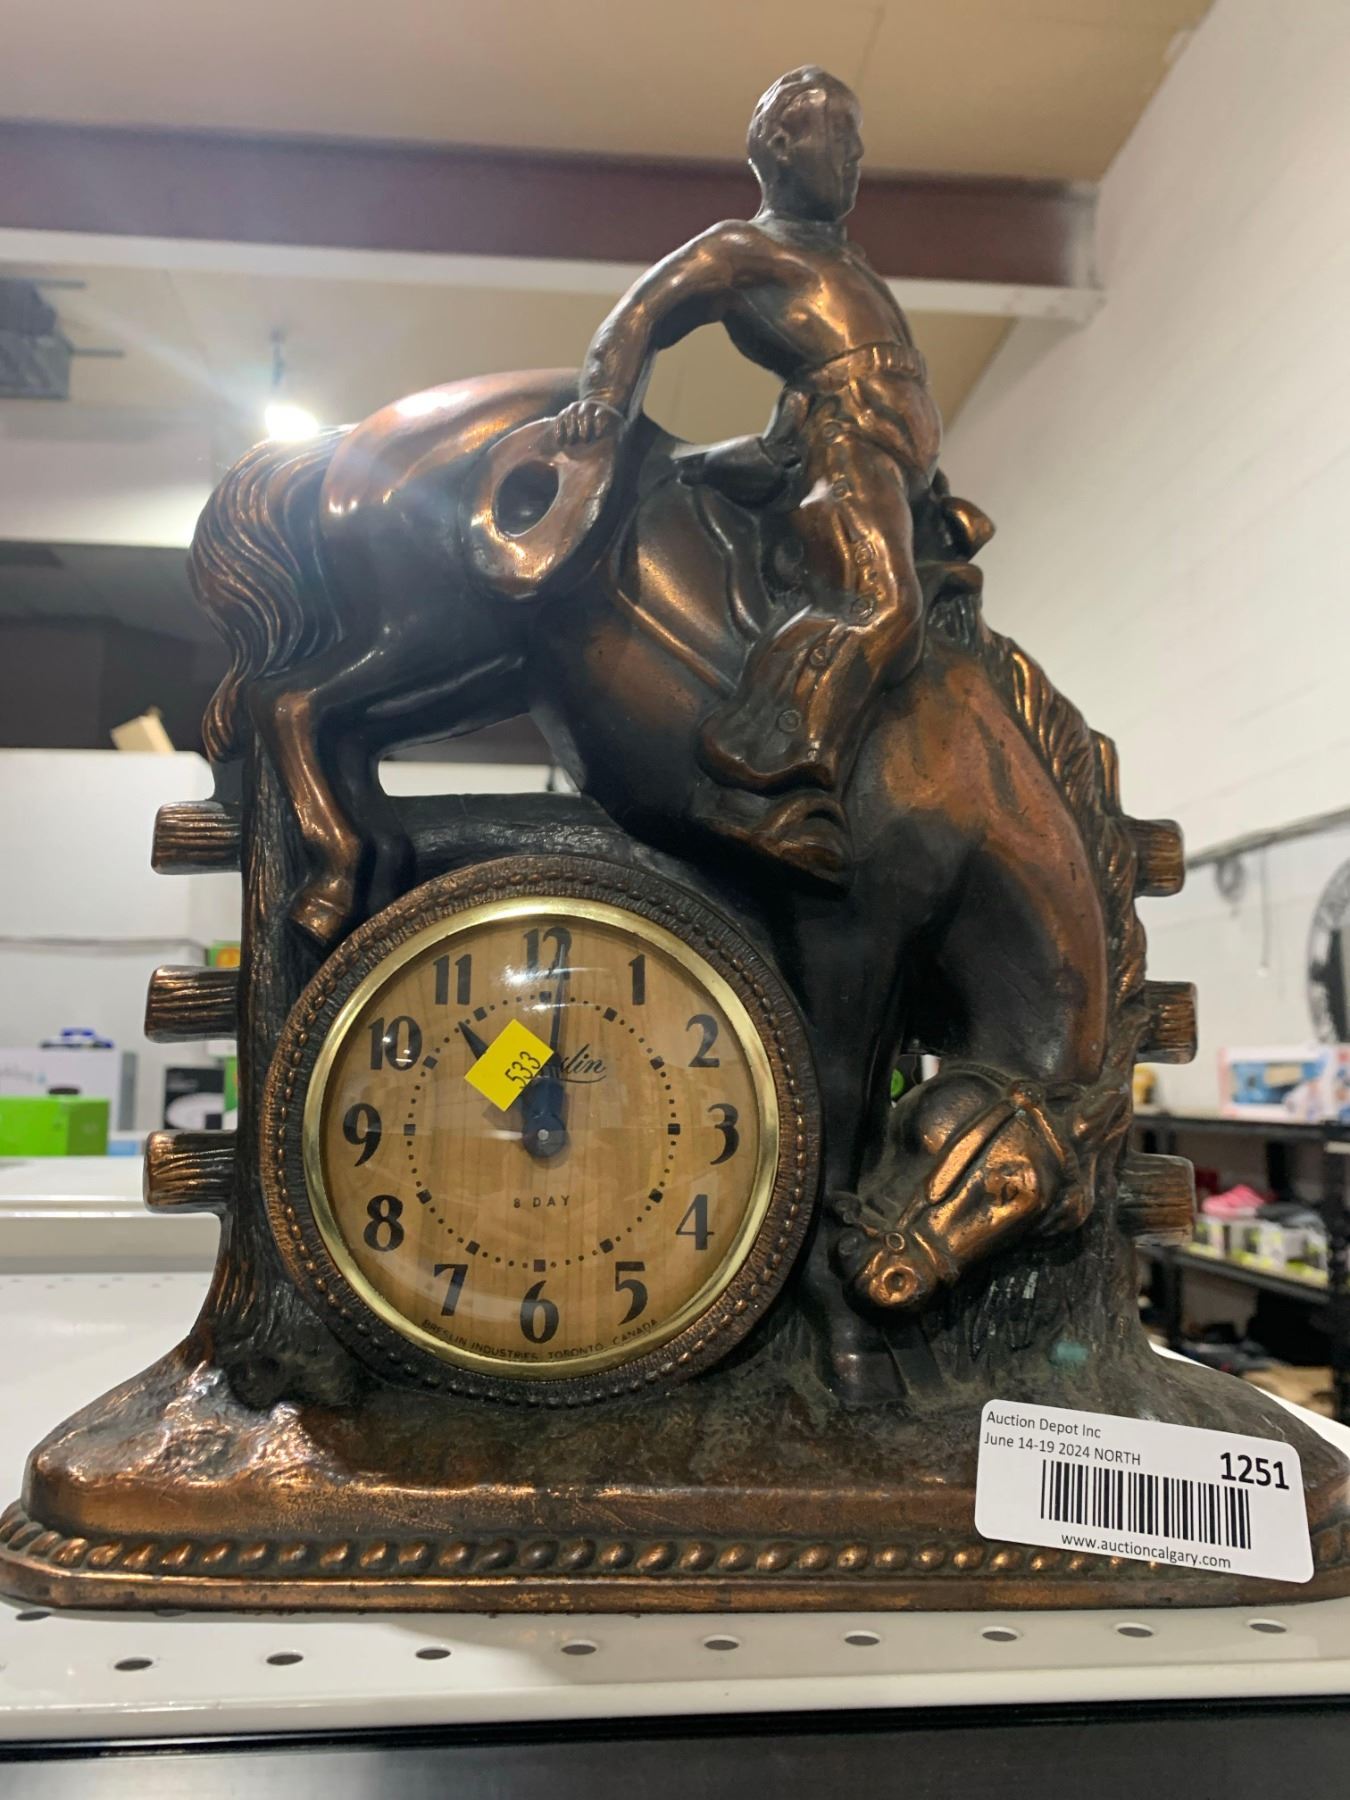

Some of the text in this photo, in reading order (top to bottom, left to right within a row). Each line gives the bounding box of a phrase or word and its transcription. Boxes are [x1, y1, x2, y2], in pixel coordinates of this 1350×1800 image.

[433, 953, 472, 1005] 11
[523, 927, 572, 981] 12
[629, 953, 645, 1005] 1
[368, 1015, 422, 1071] 10
[685, 1014, 720, 1068] 2
[504, 1051, 541, 1089] 533
[342, 1103, 382, 1167] 9
[706, 1103, 739, 1165] 3
[363, 1194, 404, 1252] 8
[513, 1195, 570, 1209] 8 DAY
[675, 1194, 714, 1251] 4
[433, 1263, 469, 1317] 7
[519, 1280, 560, 1344] 6
[614, 1262, 649, 1326] 5
[612, 1319, 658, 1346] CANADA
[984, 1432, 1141, 1466] June 14-19 2024 NORTH
[986, 1411, 1101, 1438] Auction Depot Inc
[1220, 1452, 1290, 1490] 1251
[1061, 1534, 1231, 1569] www.auctioncalgary.com
